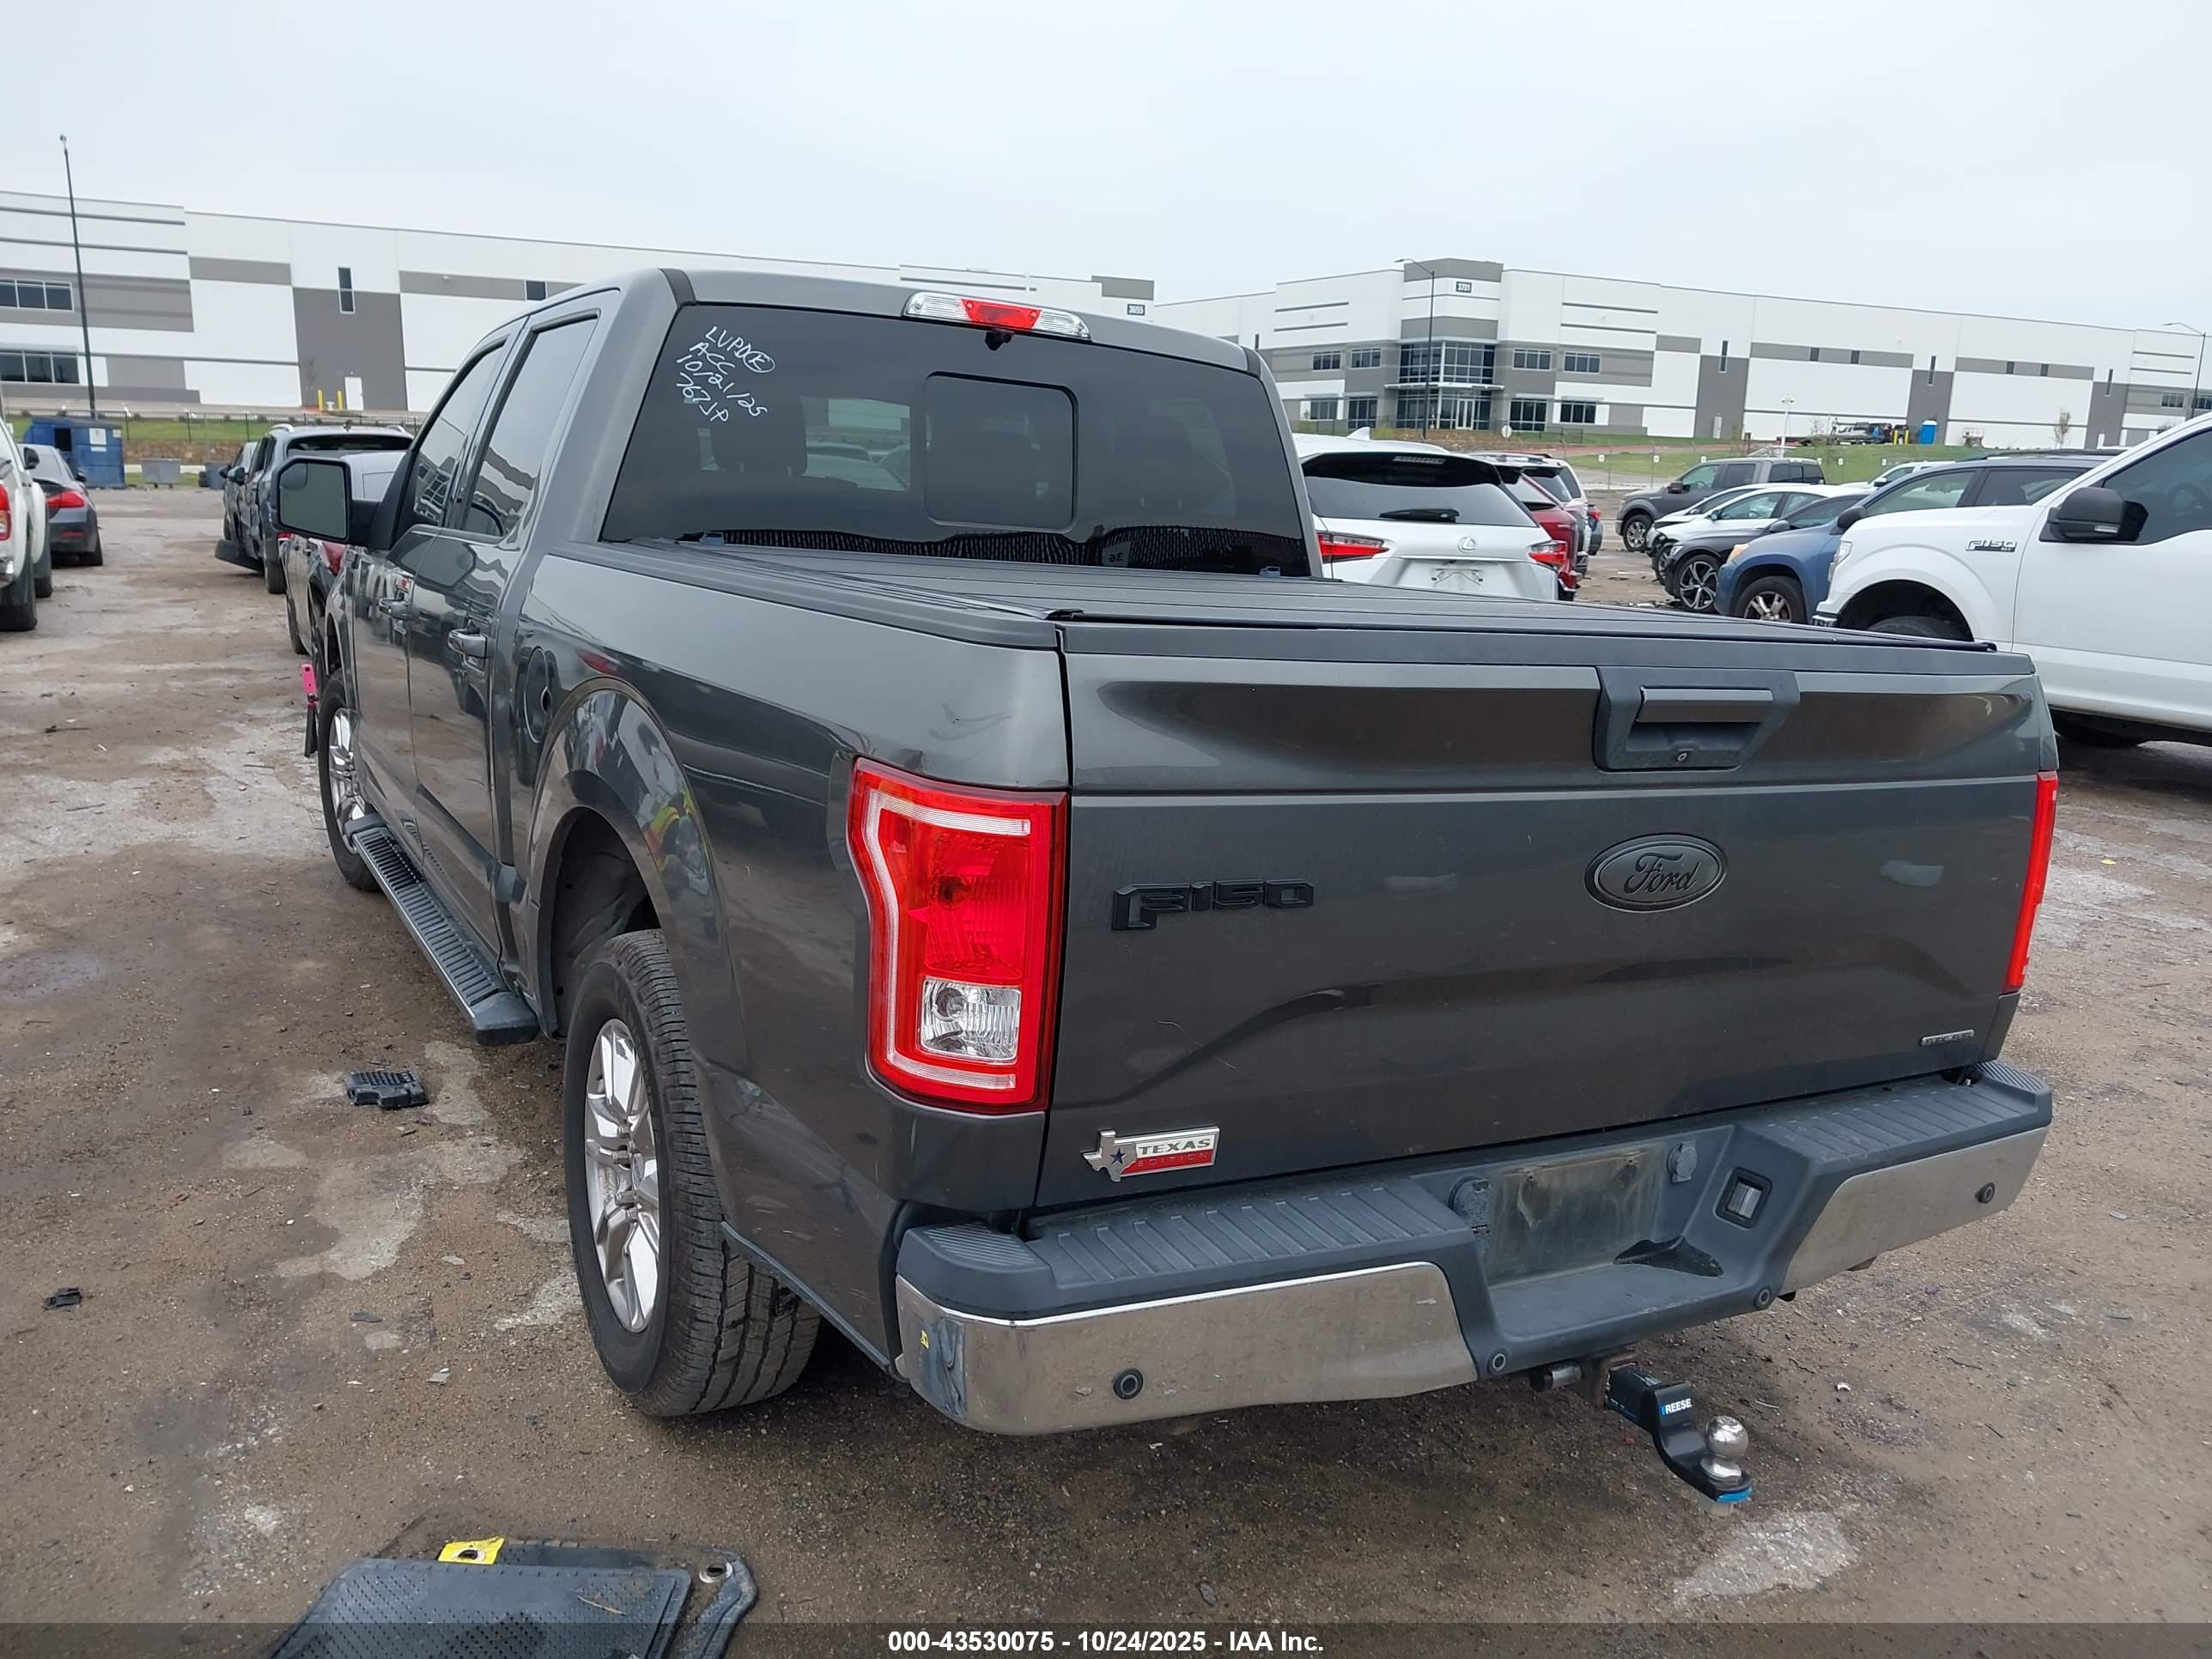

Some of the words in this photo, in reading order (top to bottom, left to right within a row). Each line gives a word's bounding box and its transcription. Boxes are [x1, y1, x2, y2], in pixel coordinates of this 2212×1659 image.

[689, 342, 736, 375] ACC
[676, 355, 769, 416] 10/21/25
[1624, 852, 1701, 895] Ford
[1113, 879, 1315, 930] F150
[1138, 1139, 1211, 1155] TEXAS
[1664, 1398, 1692, 1415] REESE
